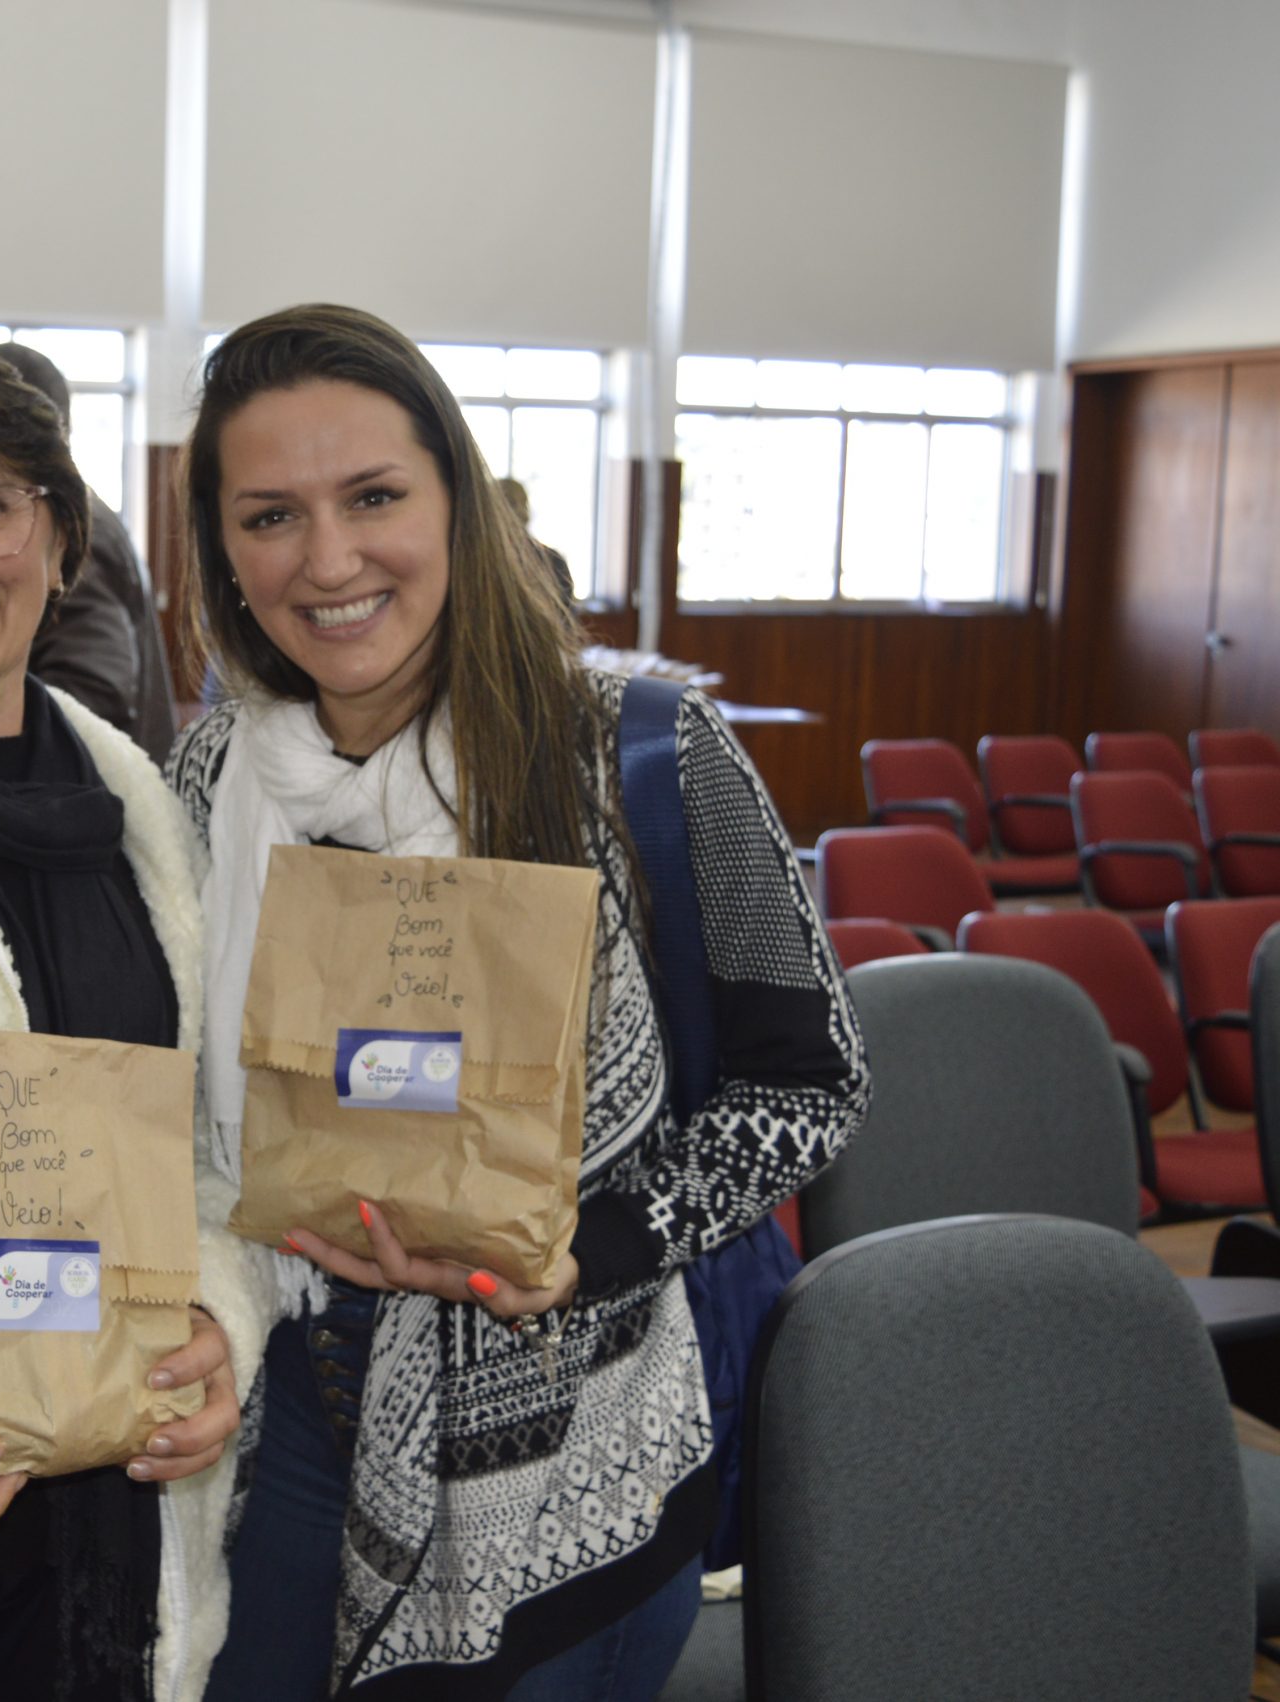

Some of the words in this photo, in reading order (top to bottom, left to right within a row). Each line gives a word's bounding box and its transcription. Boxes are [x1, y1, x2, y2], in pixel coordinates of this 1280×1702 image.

[396, 878, 440, 908] QUE
[393, 914, 443, 942] Bom
[387, 941, 413, 966] que
[418, 938, 454, 958] você
[366, 1072, 415, 1084] Cooperar
[376, 1065, 392, 1074] Dia
[395, 1065, 408, 1075] de
[0, 1121, 57, 1158] Bom
[0, 1158, 25, 1188] que
[33, 1150, 67, 1171] você
[5, 1288, 54, 1301] Cooperar
[14, 1279, 31, 1290] Dia
[33, 1279, 46, 1290] de
